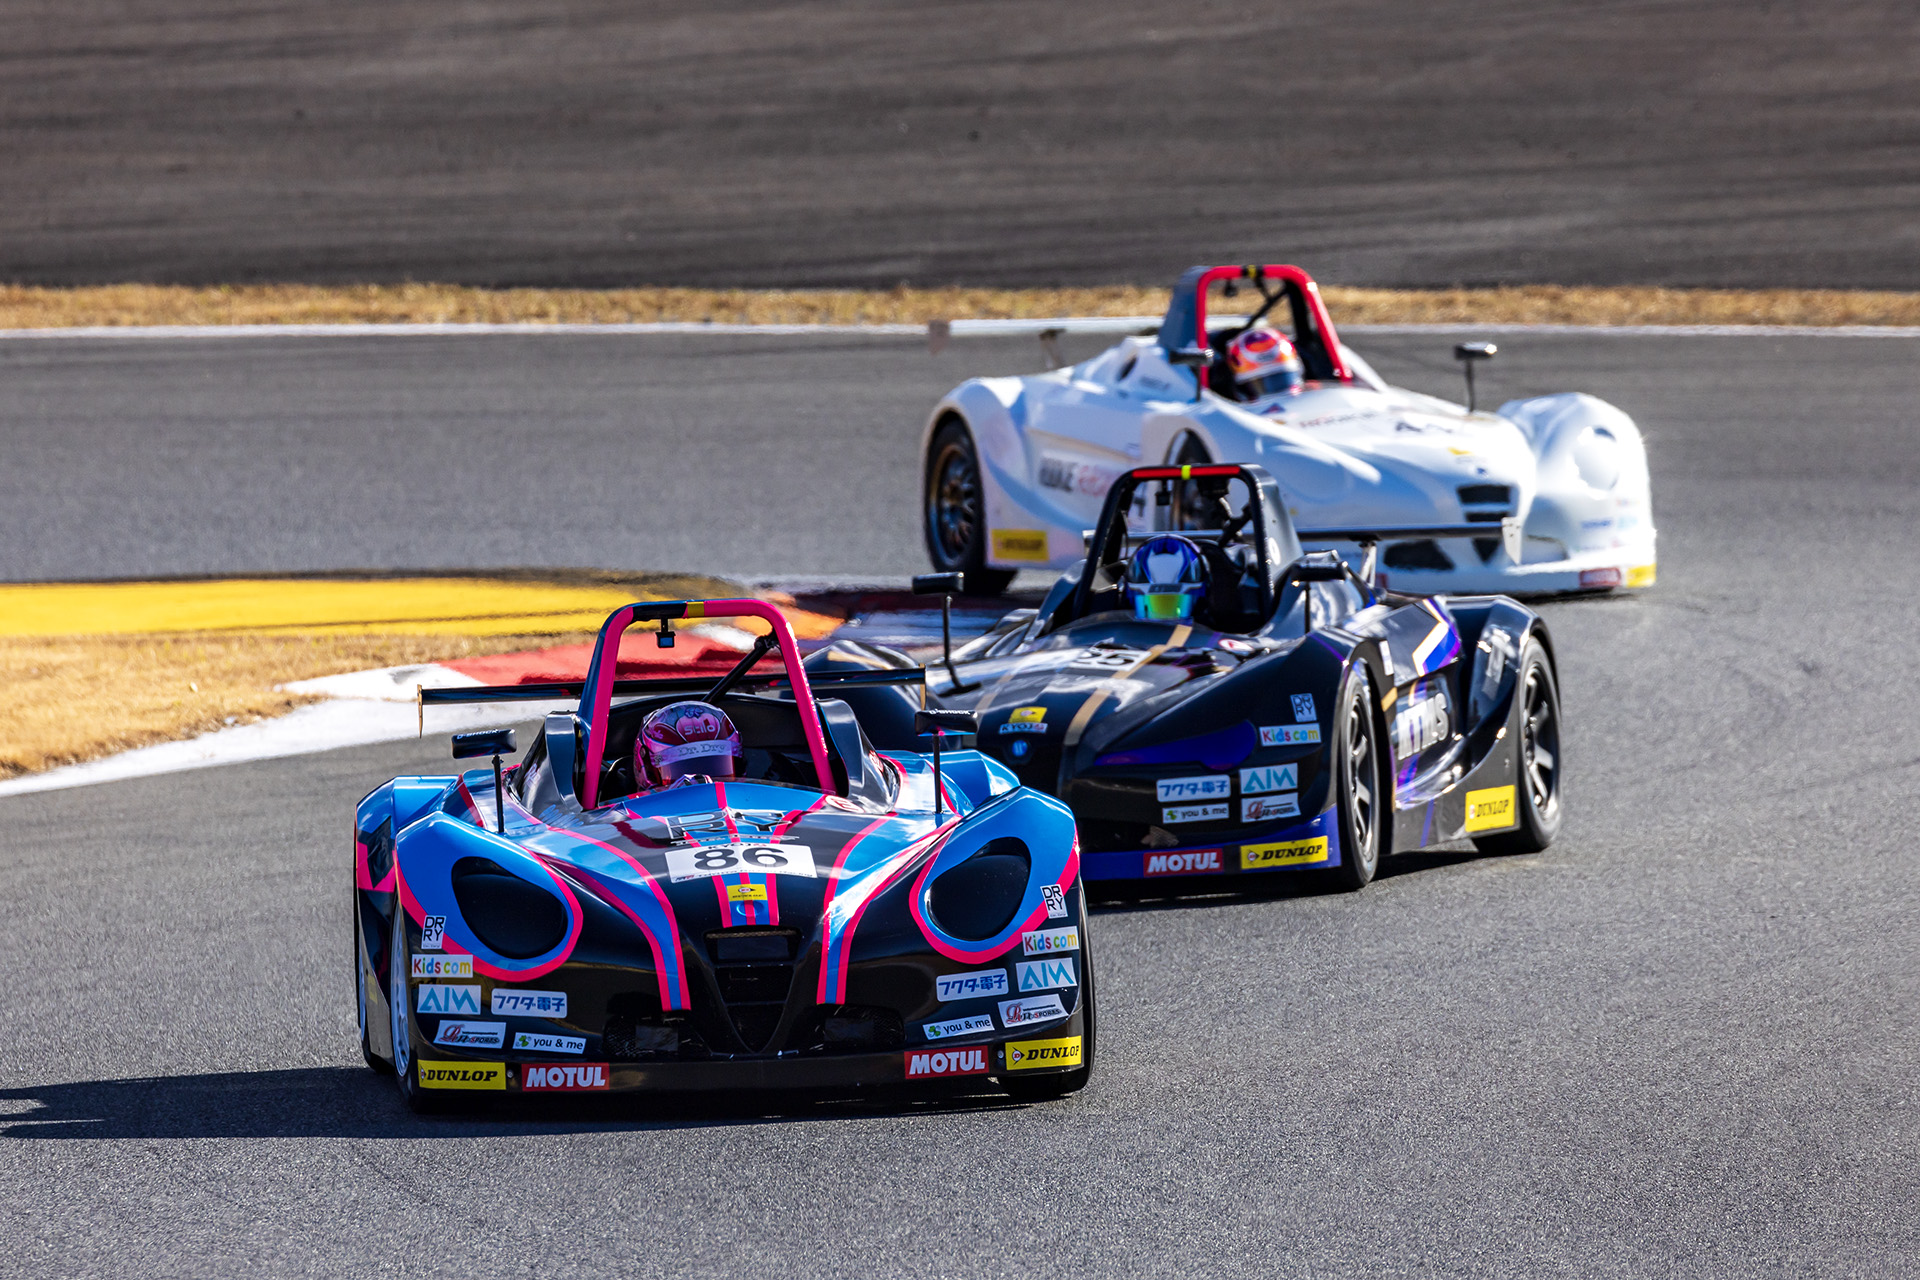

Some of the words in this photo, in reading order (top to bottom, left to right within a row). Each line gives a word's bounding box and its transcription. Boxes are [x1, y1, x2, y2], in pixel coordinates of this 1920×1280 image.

[1263, 728, 1292, 743] Kids
[1293, 729, 1319, 741] com
[1181, 809, 1200, 819] you
[1212, 807, 1227, 816] me
[694, 847, 789, 871] 86
[1261, 844, 1323, 861] DUNLOP
[1147, 852, 1221, 872] MOTUL
[1041, 885, 1063, 899] DR
[1045, 897, 1064, 911] RY
[424, 916, 446, 929] DR
[423, 928, 444, 942] RY
[1024, 935, 1052, 953] Kids
[1053, 933, 1078, 948] com
[413, 958, 442, 975] Kids
[443, 961, 471, 975] com
[938, 974, 1006, 996] フクダ電子
[493, 995, 566, 1012] フクダ電子
[943, 1022, 963, 1035] you
[965, 1020, 974, 1030] &
[976, 1018, 991, 1029] me
[533, 1038, 552, 1050] you
[555, 1039, 564, 1048] &
[566, 1041, 584, 1050] me
[1026, 1044, 1080, 1061] DUNLOP
[909, 1050, 986, 1075] MOTUL
[427, 1069, 498, 1082] DUNLOP
[526, 1066, 606, 1088] MOTUL
